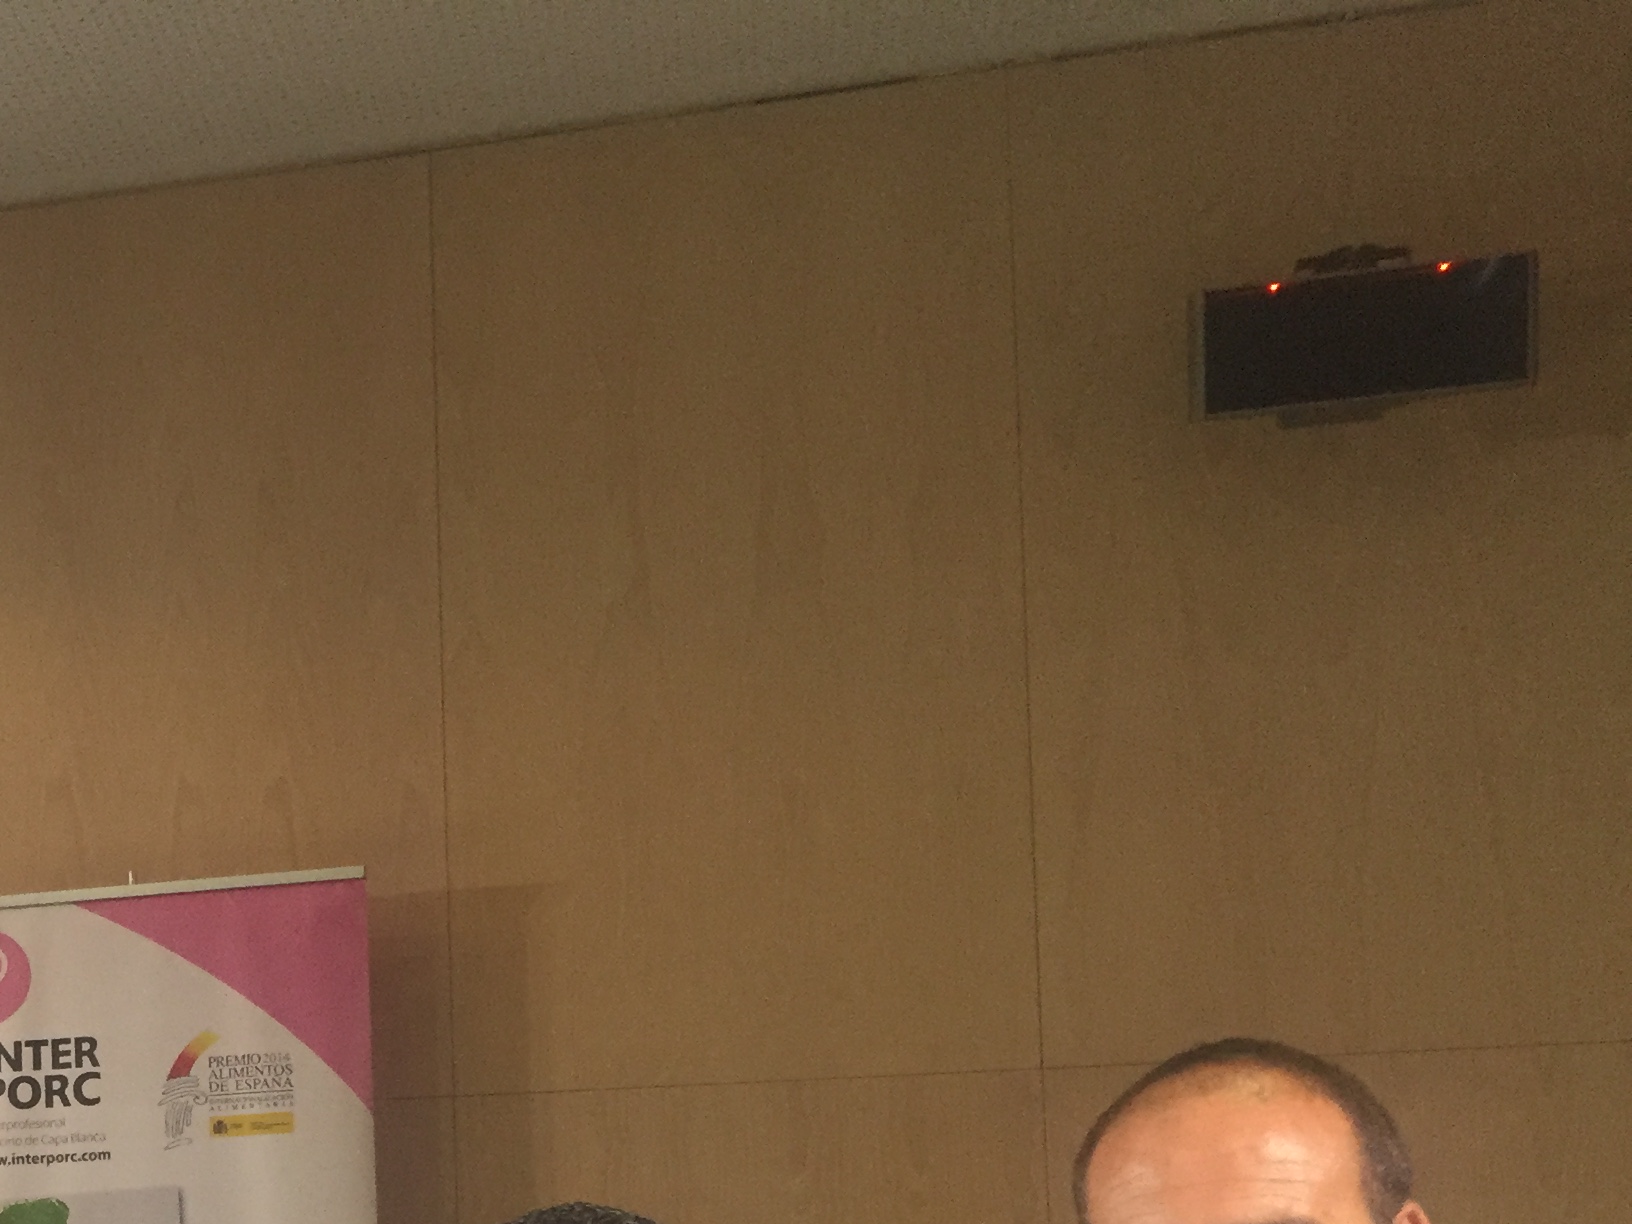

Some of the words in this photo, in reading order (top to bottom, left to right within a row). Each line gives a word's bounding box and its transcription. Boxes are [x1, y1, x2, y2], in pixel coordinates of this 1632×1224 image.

[208, 1053, 262, 1068] PREMIO
[209, 1064, 294, 1080] ALIMENTOS
[209, 1080, 230, 1093] DE
[25, 1135, 39, 1146] de
[40, 1134, 69, 1148] Capa
